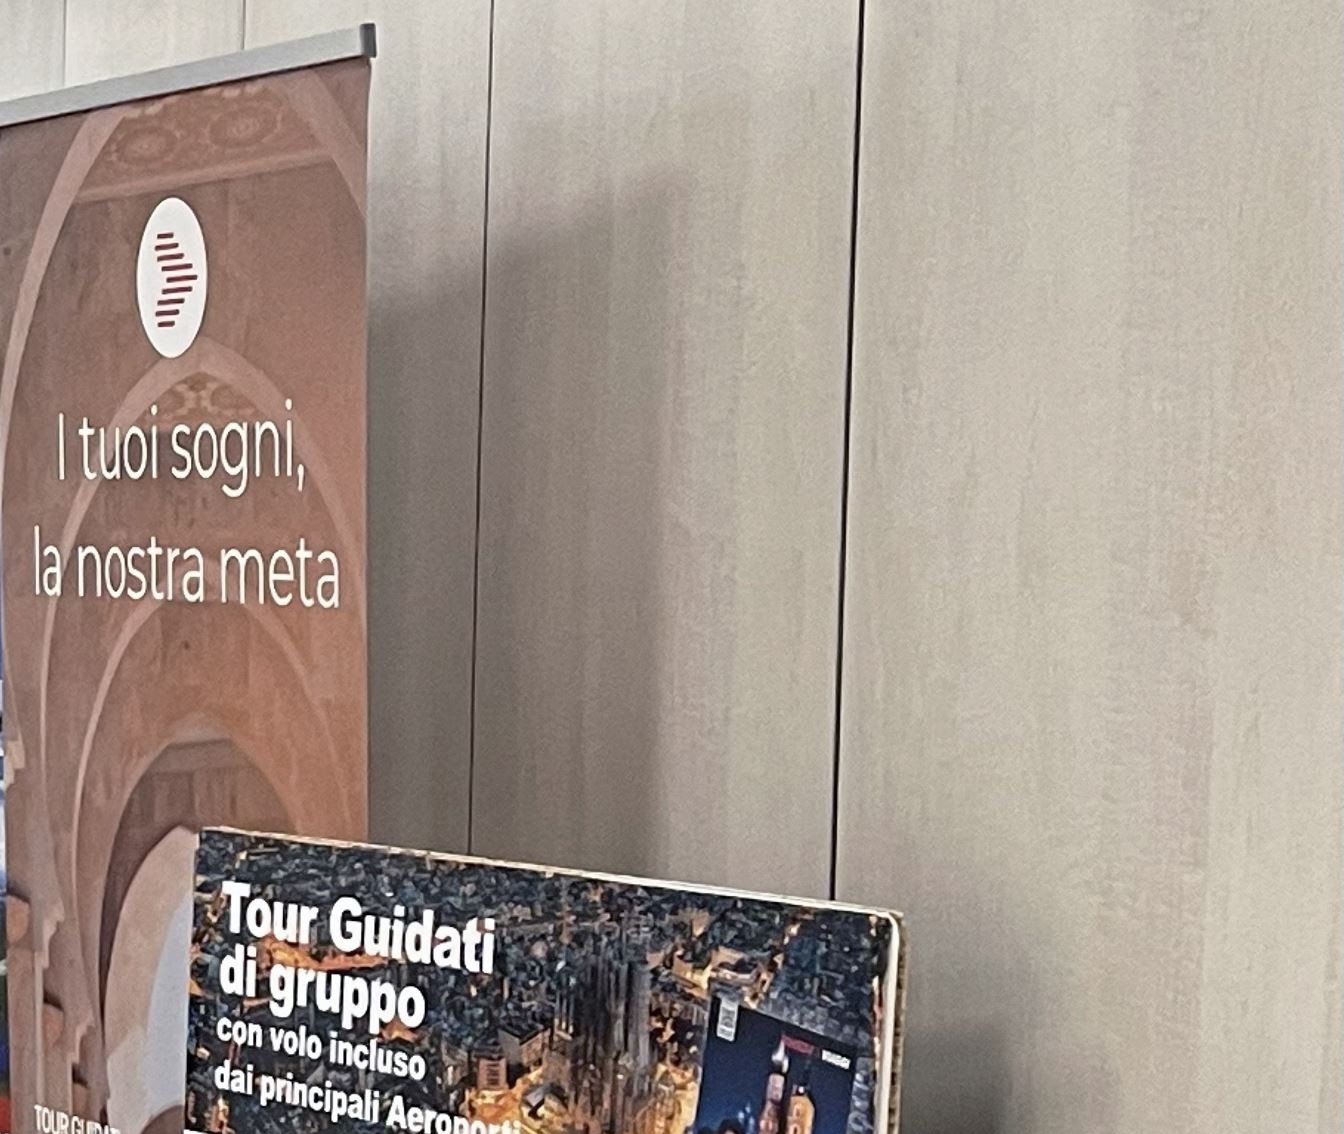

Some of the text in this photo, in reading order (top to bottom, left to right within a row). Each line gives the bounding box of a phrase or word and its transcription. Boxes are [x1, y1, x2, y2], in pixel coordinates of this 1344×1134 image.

[58, 397, 305, 498] I tuoi sogni,
[33, 524, 340, 609] la nostra meta
[221, 880, 496, 975] Tour Guidati
[219, 943, 426, 1035] di gruppo
[214, 1060, 253, 1095] dai
[260, 1073, 380, 1123] principali
[216, 1017, 426, 1080] con volo incluso
